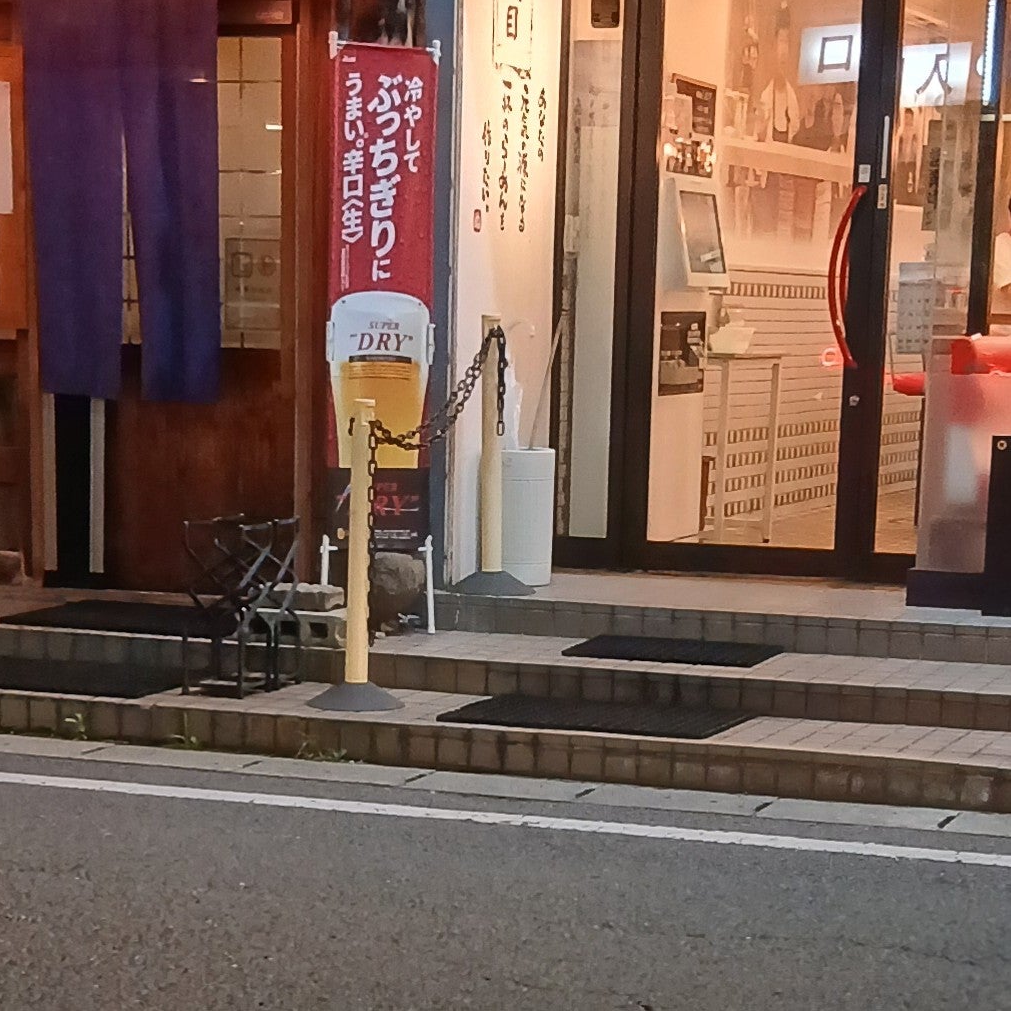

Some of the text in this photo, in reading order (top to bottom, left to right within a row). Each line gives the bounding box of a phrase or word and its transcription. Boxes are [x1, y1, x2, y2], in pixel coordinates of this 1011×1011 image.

[404, 76, 424, 173] 冷やして
[367, 74, 402, 282] ぶっちぎりに
[368, 320, 400, 331] SUPER
